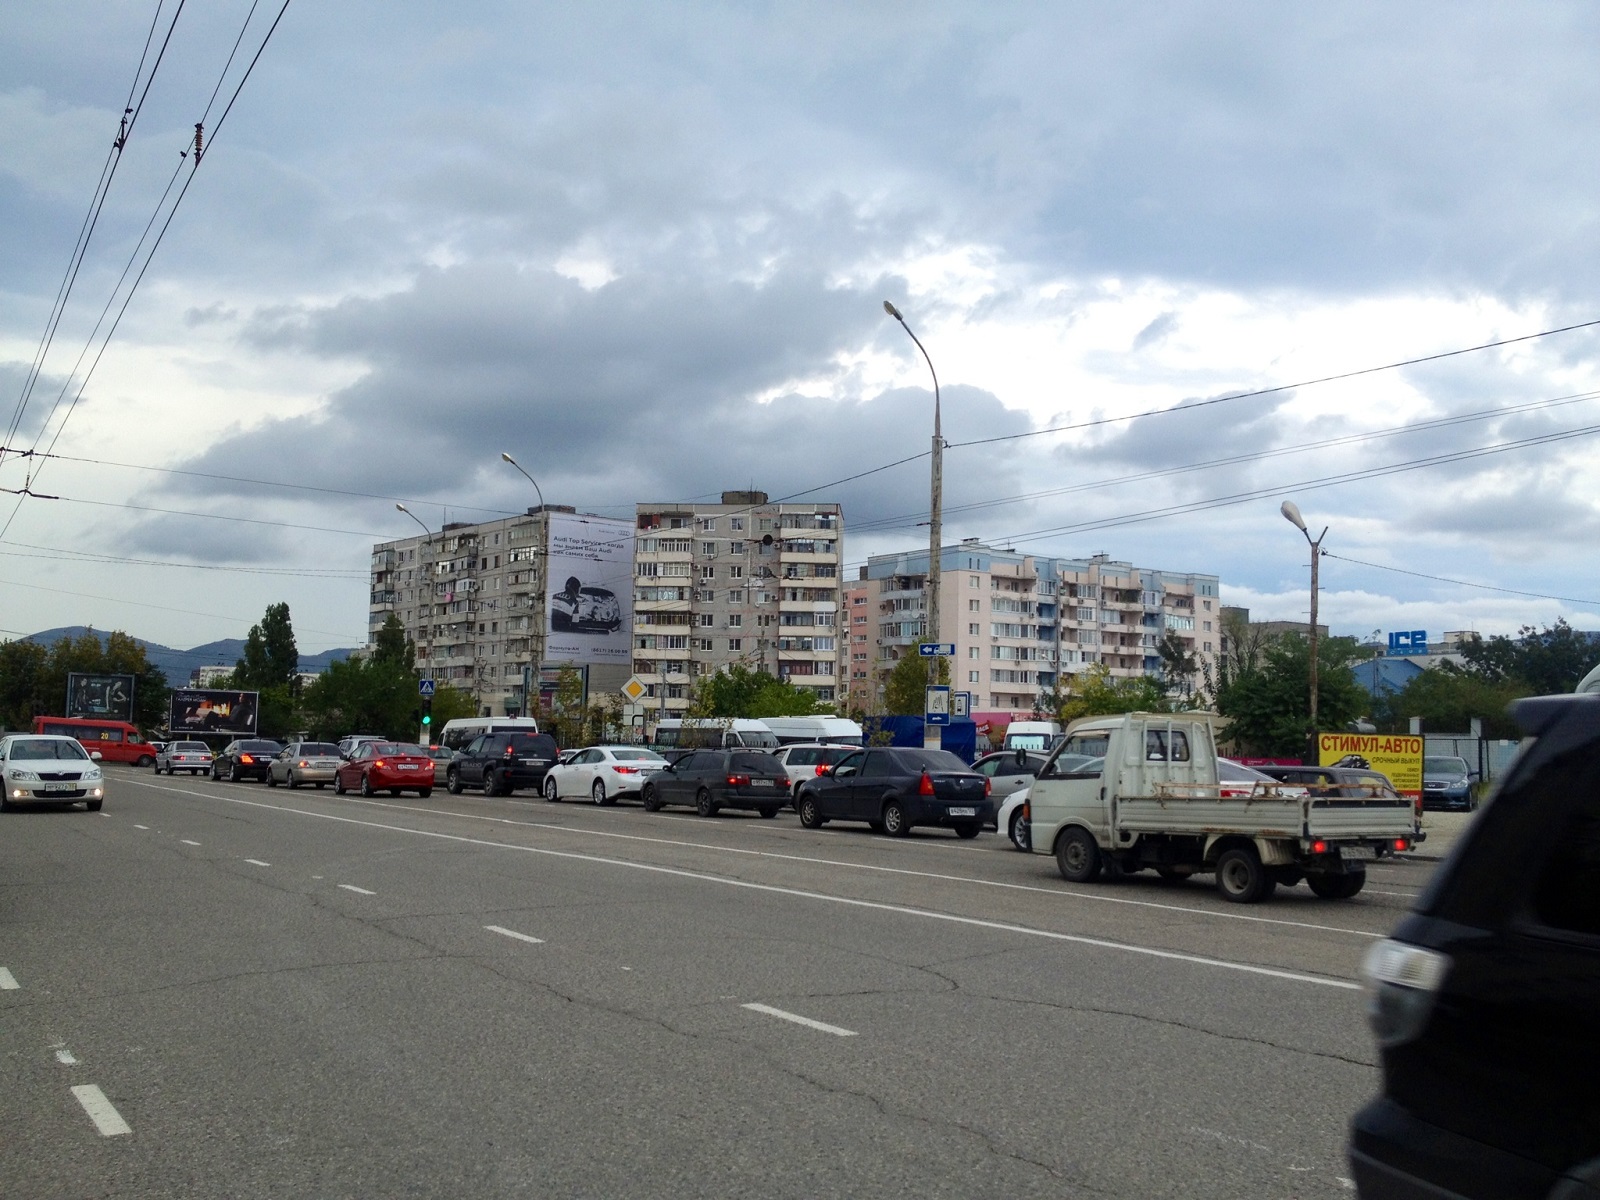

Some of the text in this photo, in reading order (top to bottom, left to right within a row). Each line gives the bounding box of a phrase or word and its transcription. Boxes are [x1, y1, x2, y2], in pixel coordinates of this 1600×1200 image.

[100, 732, 109, 740] 20
[1321, 735, 1421, 754] СТИМУЛ-АВТО
[1371, 756, 1400, 764] СРОЧНЫЙ
